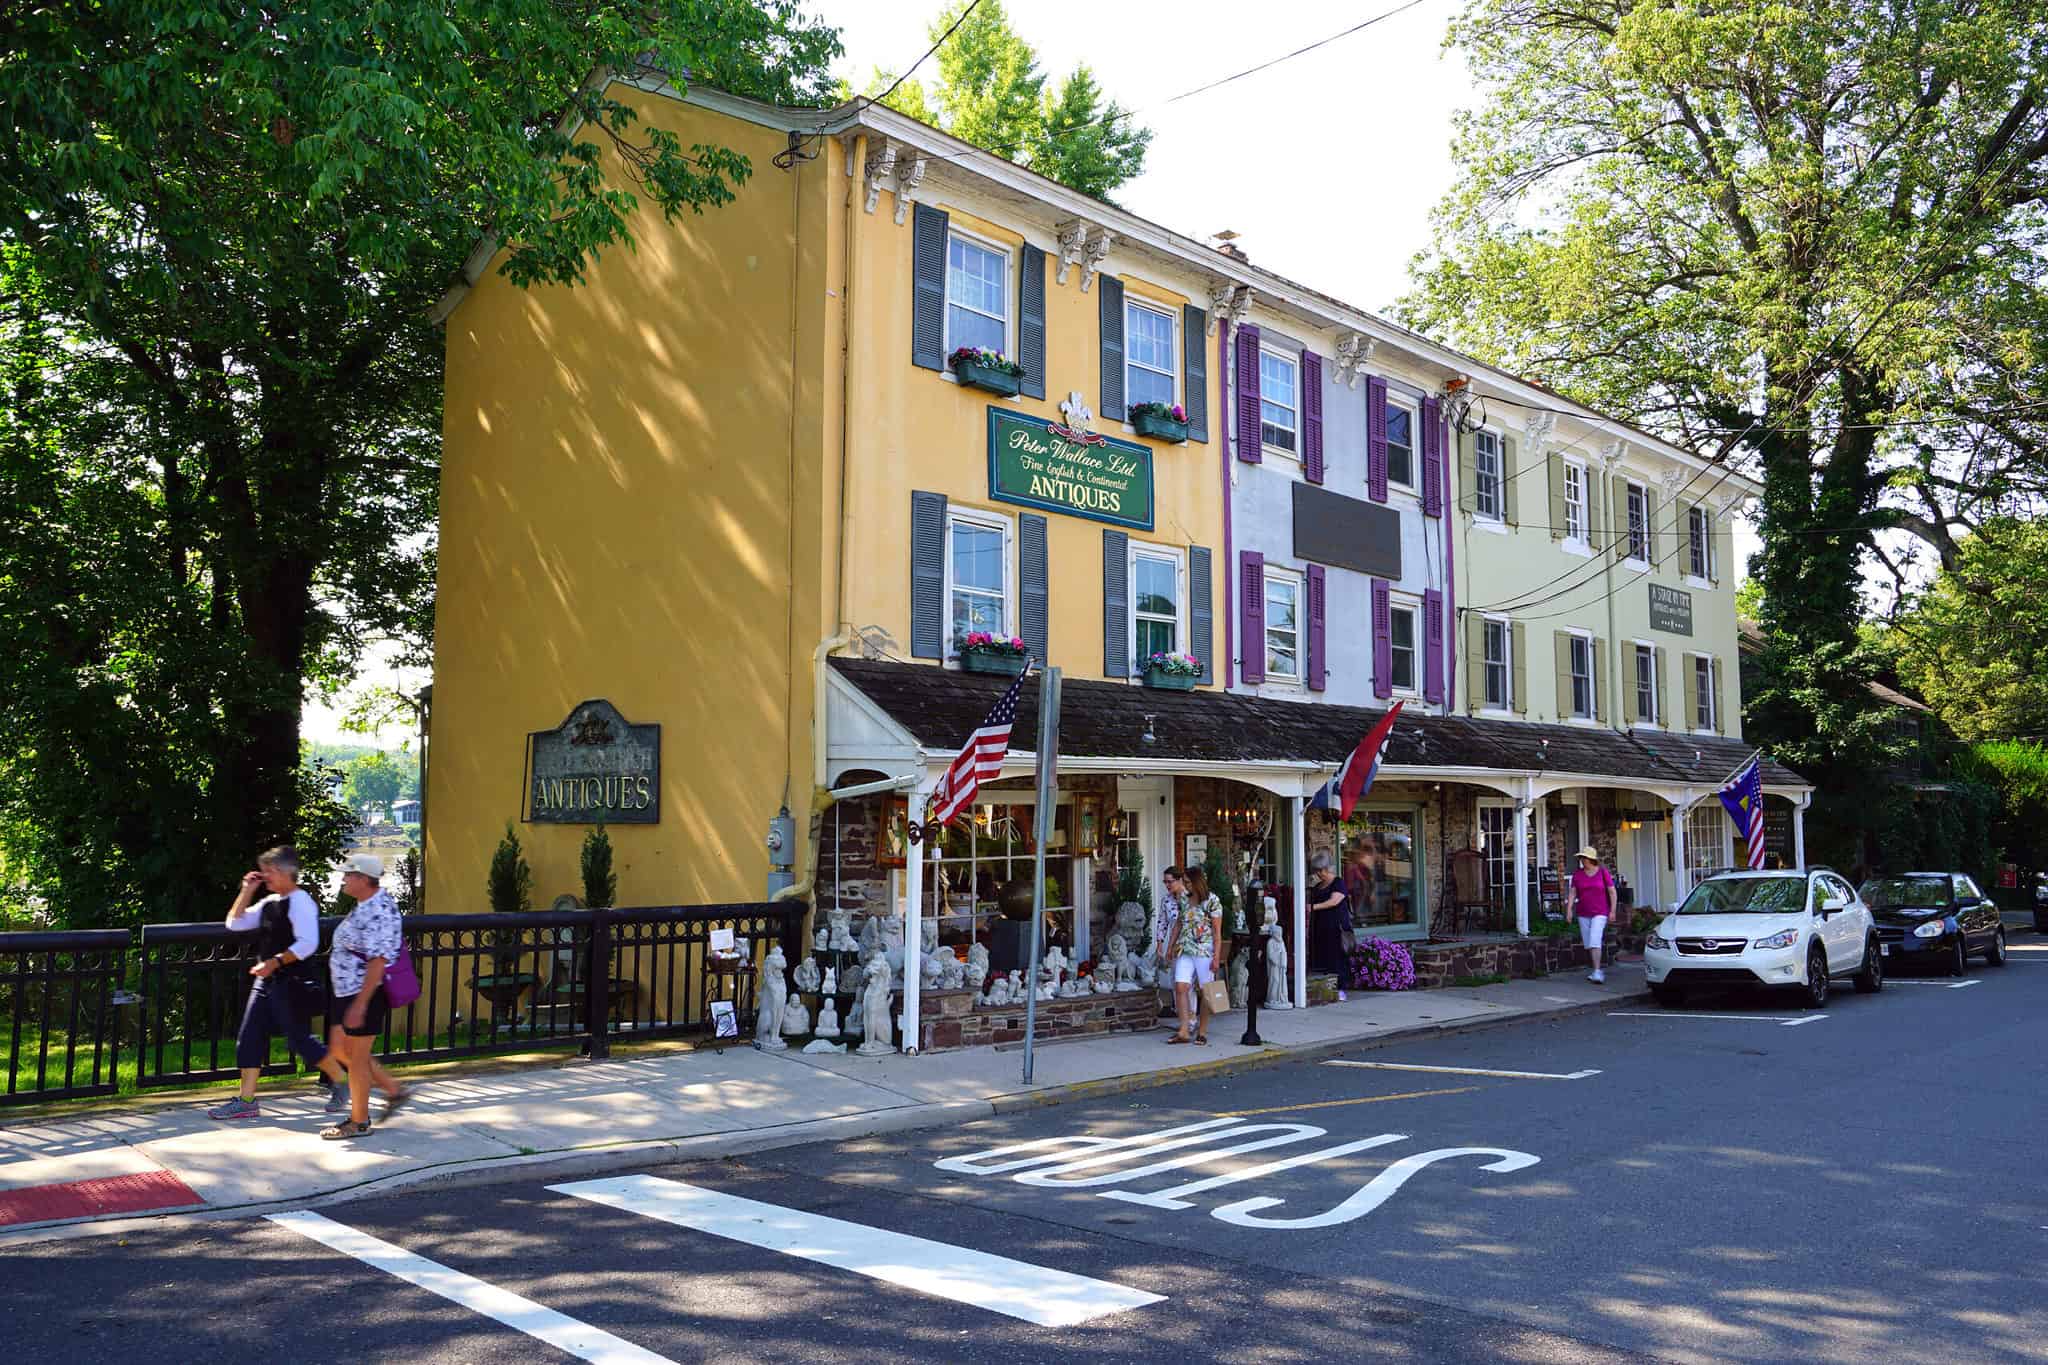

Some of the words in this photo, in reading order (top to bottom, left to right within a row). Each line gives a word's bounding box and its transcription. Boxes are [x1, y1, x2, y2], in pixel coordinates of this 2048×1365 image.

[1009, 430, 1048, 454] Peter
[1050, 439, 1103, 469] Wallace
[1105, 454, 1137, 477] Ltd.
[1020, 455, 1044, 471] Fine
[1047, 459, 1075, 481] English
[1077, 469, 1084, 481] &
[1029, 474, 1121, 513] ANTIQUES
[535, 776, 651, 810] ANTIQUES
[933, 1116, 1541, 1230] STOP
